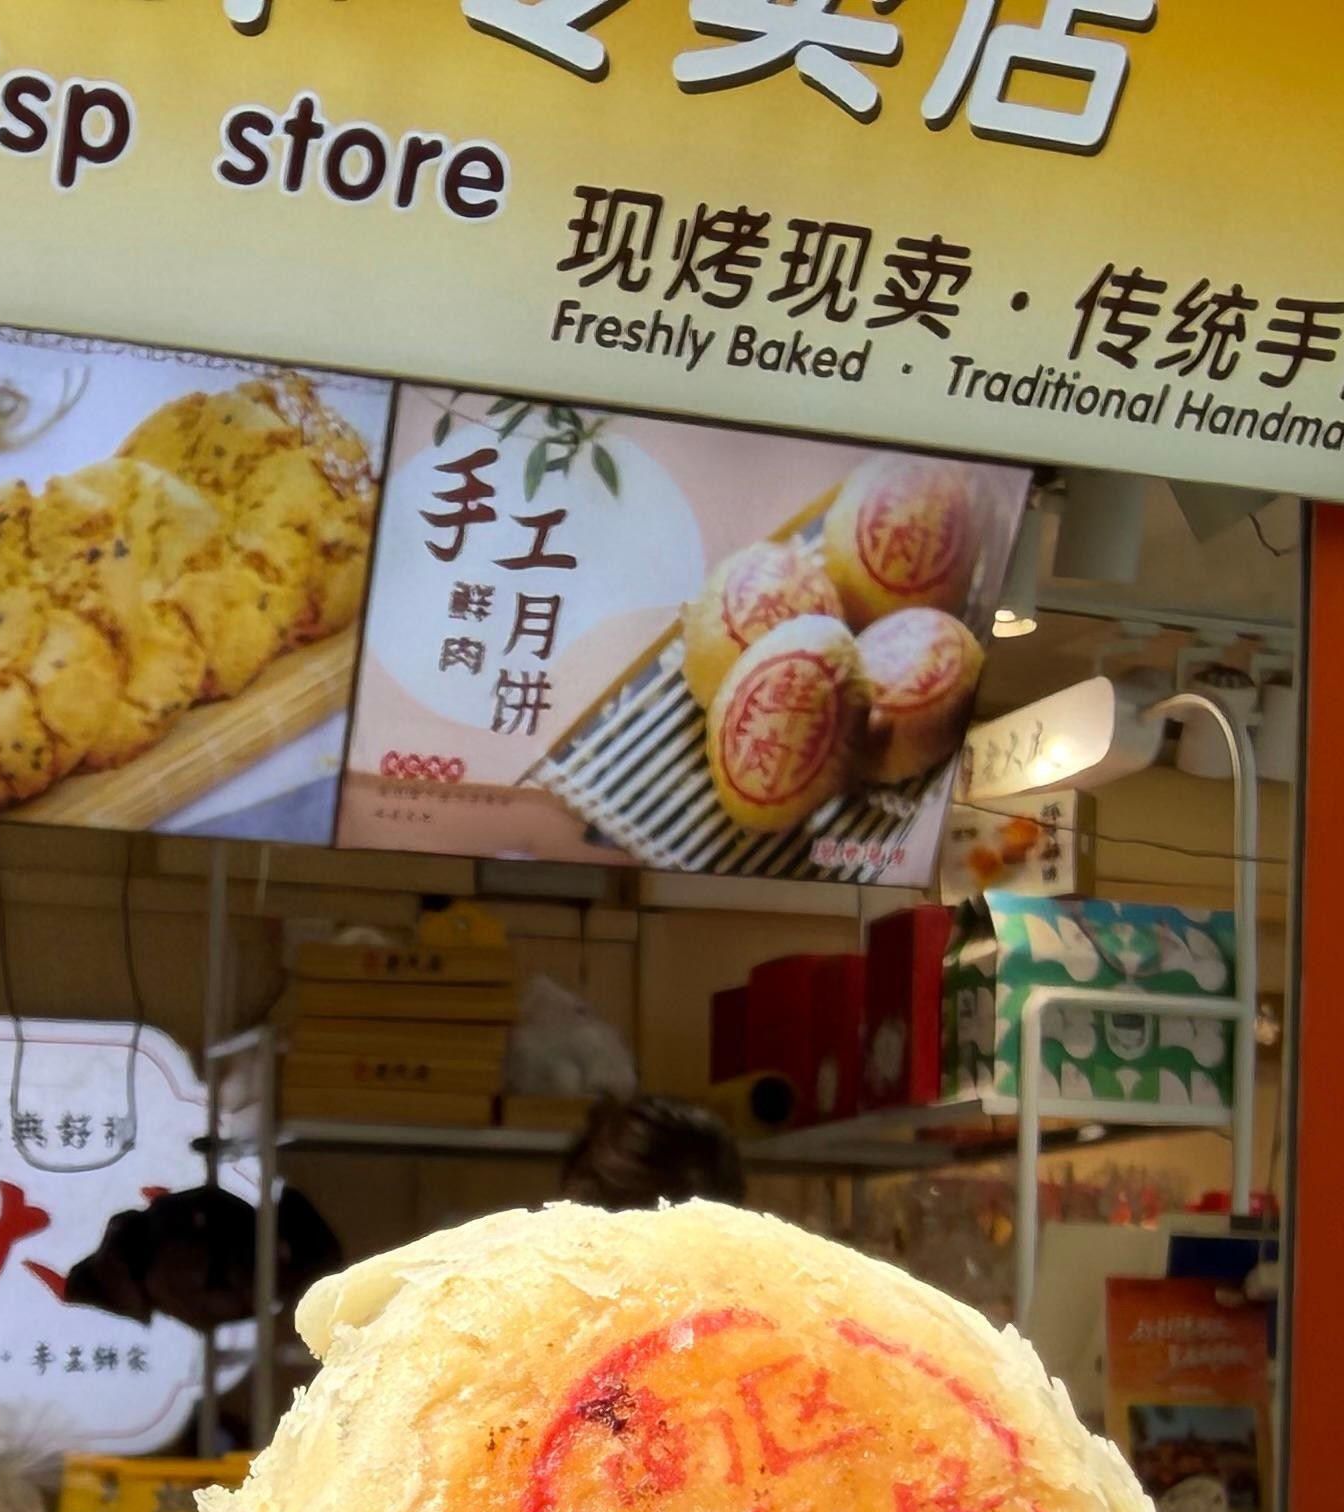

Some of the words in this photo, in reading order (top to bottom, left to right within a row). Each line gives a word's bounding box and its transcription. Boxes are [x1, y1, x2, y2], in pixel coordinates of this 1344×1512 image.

[218, 97, 506, 218] store
[551, 301, 716, 371] Freshly
[727, 329, 870, 383] Baked
[947, 356, 1166, 427] Traditional
